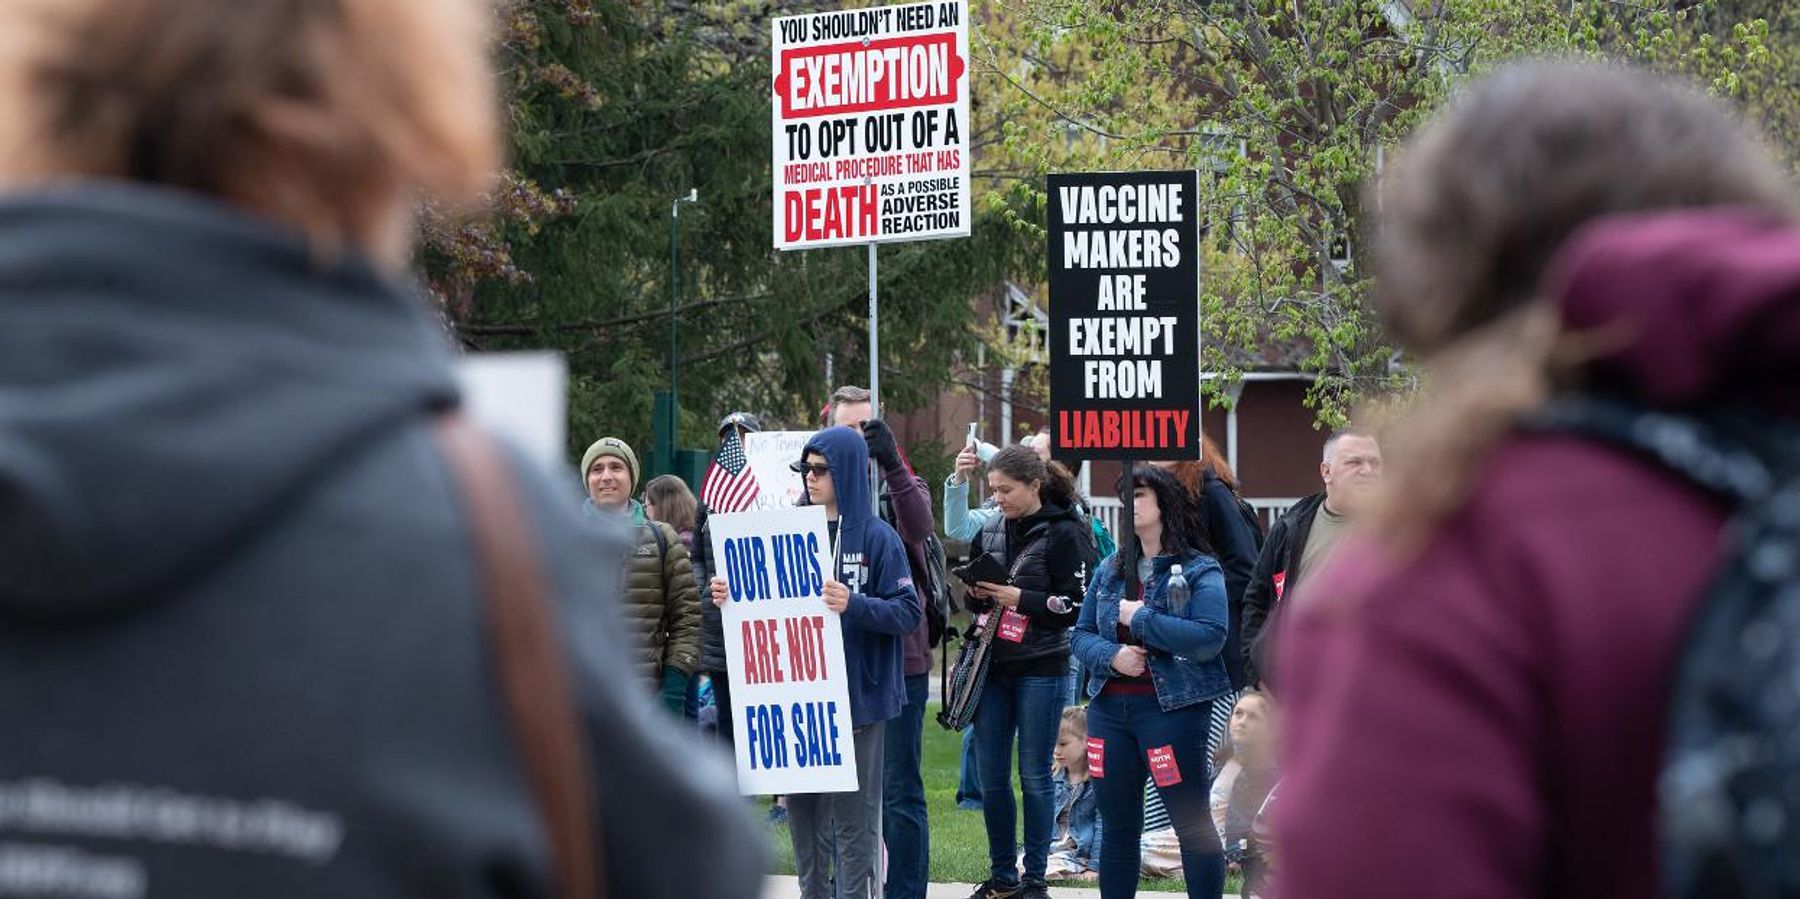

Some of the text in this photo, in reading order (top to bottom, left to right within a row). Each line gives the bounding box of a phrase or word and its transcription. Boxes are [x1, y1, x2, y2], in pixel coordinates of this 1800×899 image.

[780, 2, 959, 44] YOU SHOULDN'T NEED AN
[789, 42, 949, 111] EXEMPTION
[785, 108, 960, 161] TO OPT OUT OF A
[784, 149, 960, 185] MEDICAL PROCEDURE THAT HAS
[881, 176, 960, 197] AS A POSSIBLE
[785, 183, 878, 243] DEATH
[881, 192, 959, 216] ADVERSE
[882, 211, 960, 235] REACTION
[1059, 183, 1184, 224] VACCINE
[1064, 229, 1181, 269] MAKERS
[1097, 274, 1148, 311] ARE
[1069, 316, 1178, 356] EXEMPT
[1084, 360, 1162, 399] FROM
[1059, 410, 1190, 449] LIABILITY
[724, 531, 823, 603] OUR KIDS
[741, 616, 828, 685] ARE NOT
[745, 701, 842, 770] FOR SALE
